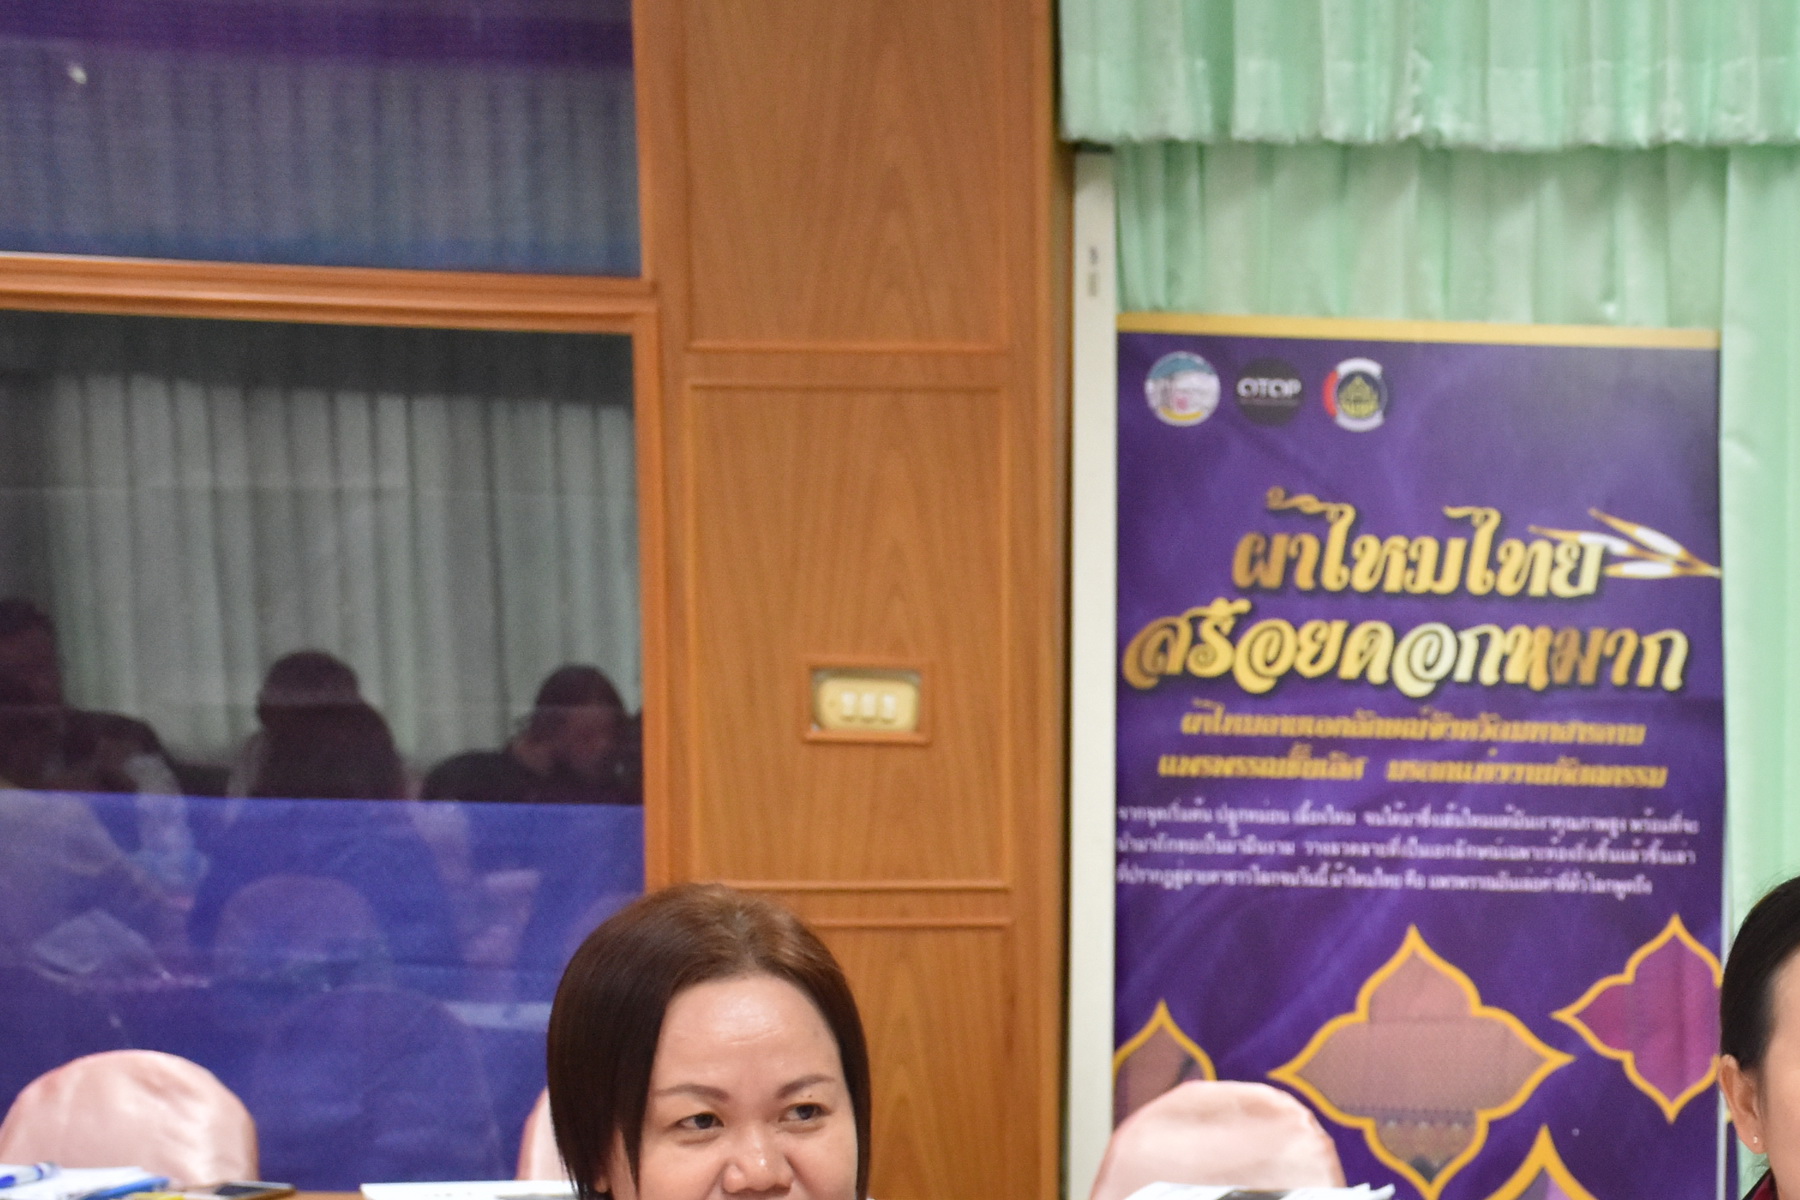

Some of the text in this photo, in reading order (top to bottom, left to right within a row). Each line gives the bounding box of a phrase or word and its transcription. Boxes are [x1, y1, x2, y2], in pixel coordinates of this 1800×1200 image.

[1236, 377, 1302, 398] OTOP
[1232, 486, 1606, 598] ผ้าไหมไทย
[1122, 597, 1689, 698] สร้อยดอกหมาก
